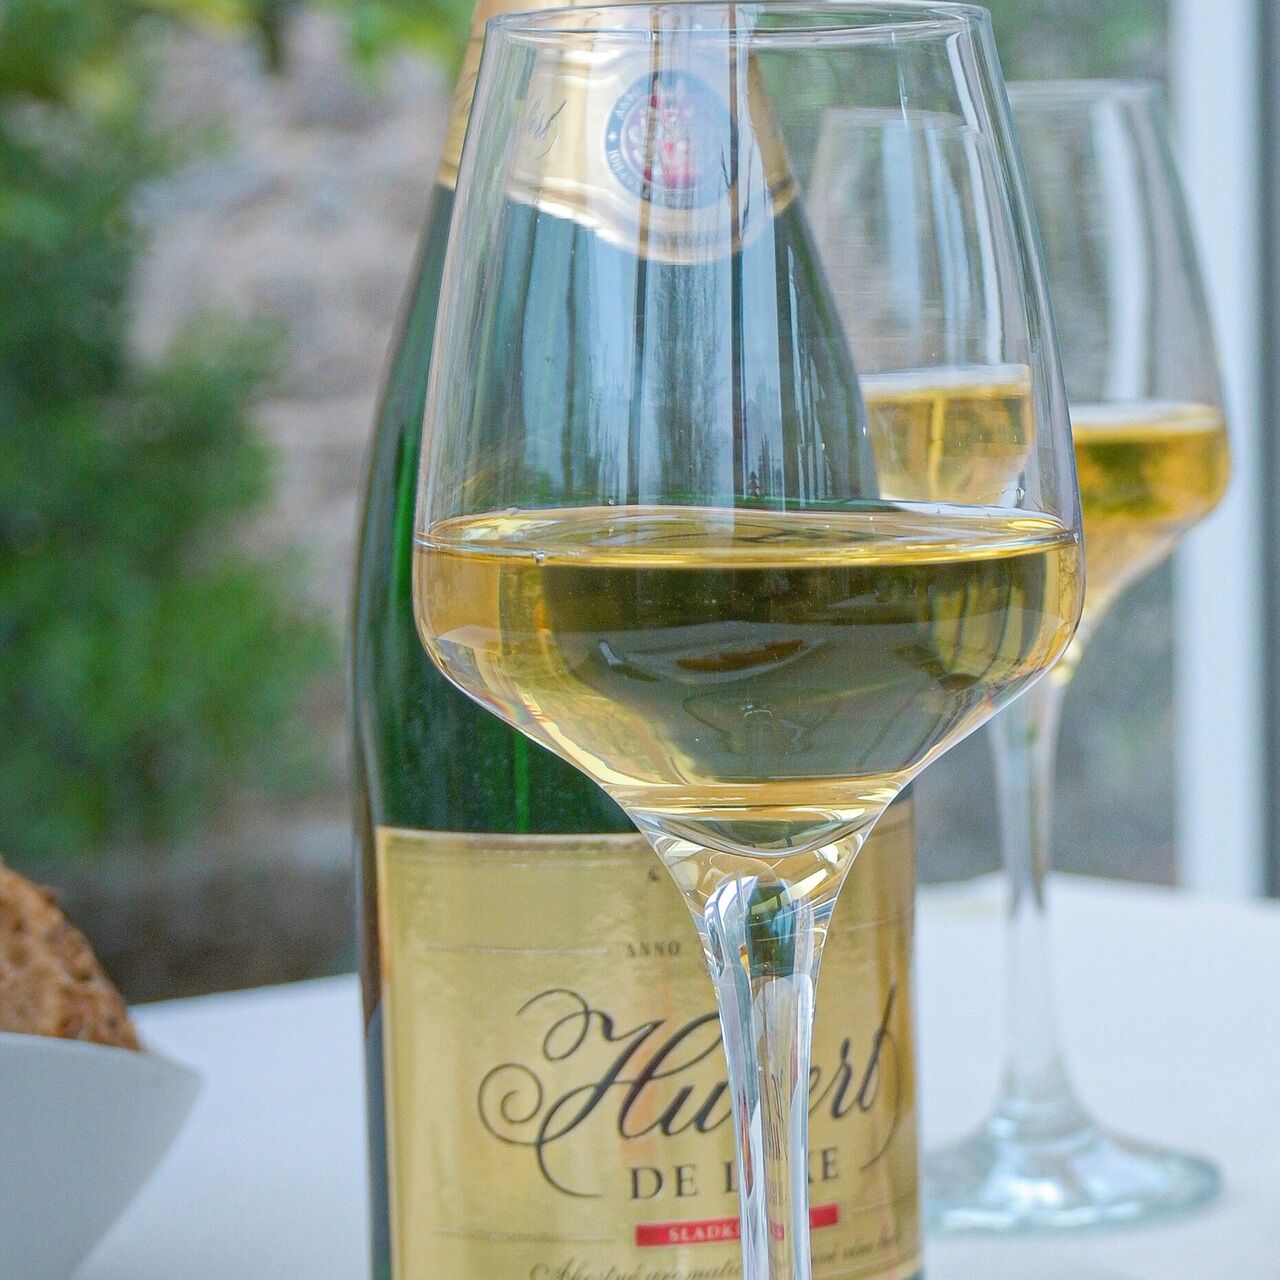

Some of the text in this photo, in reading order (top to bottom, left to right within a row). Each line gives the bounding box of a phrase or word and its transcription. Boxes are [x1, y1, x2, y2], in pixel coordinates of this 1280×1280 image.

[478, 983, 906, 1200] Huert
[631, 1147, 839, 1200] DE LE
